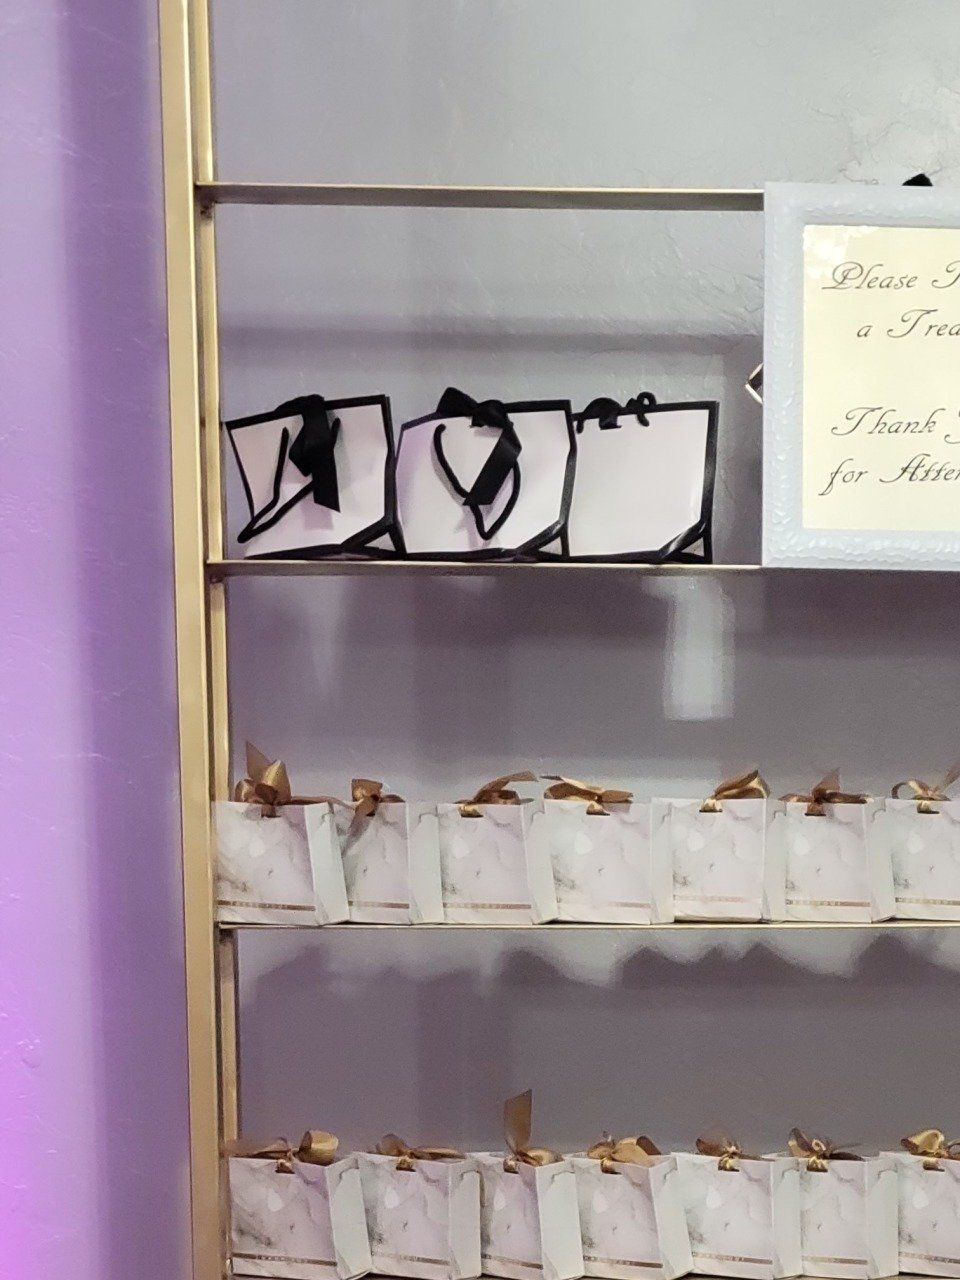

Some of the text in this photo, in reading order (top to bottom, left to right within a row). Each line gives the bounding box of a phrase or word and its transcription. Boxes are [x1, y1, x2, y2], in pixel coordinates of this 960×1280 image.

[821, 261, 918, 291] Please
[856, 324, 873, 339] a
[830, 406, 945, 436] Thank
[817, 457, 869, 497] for
